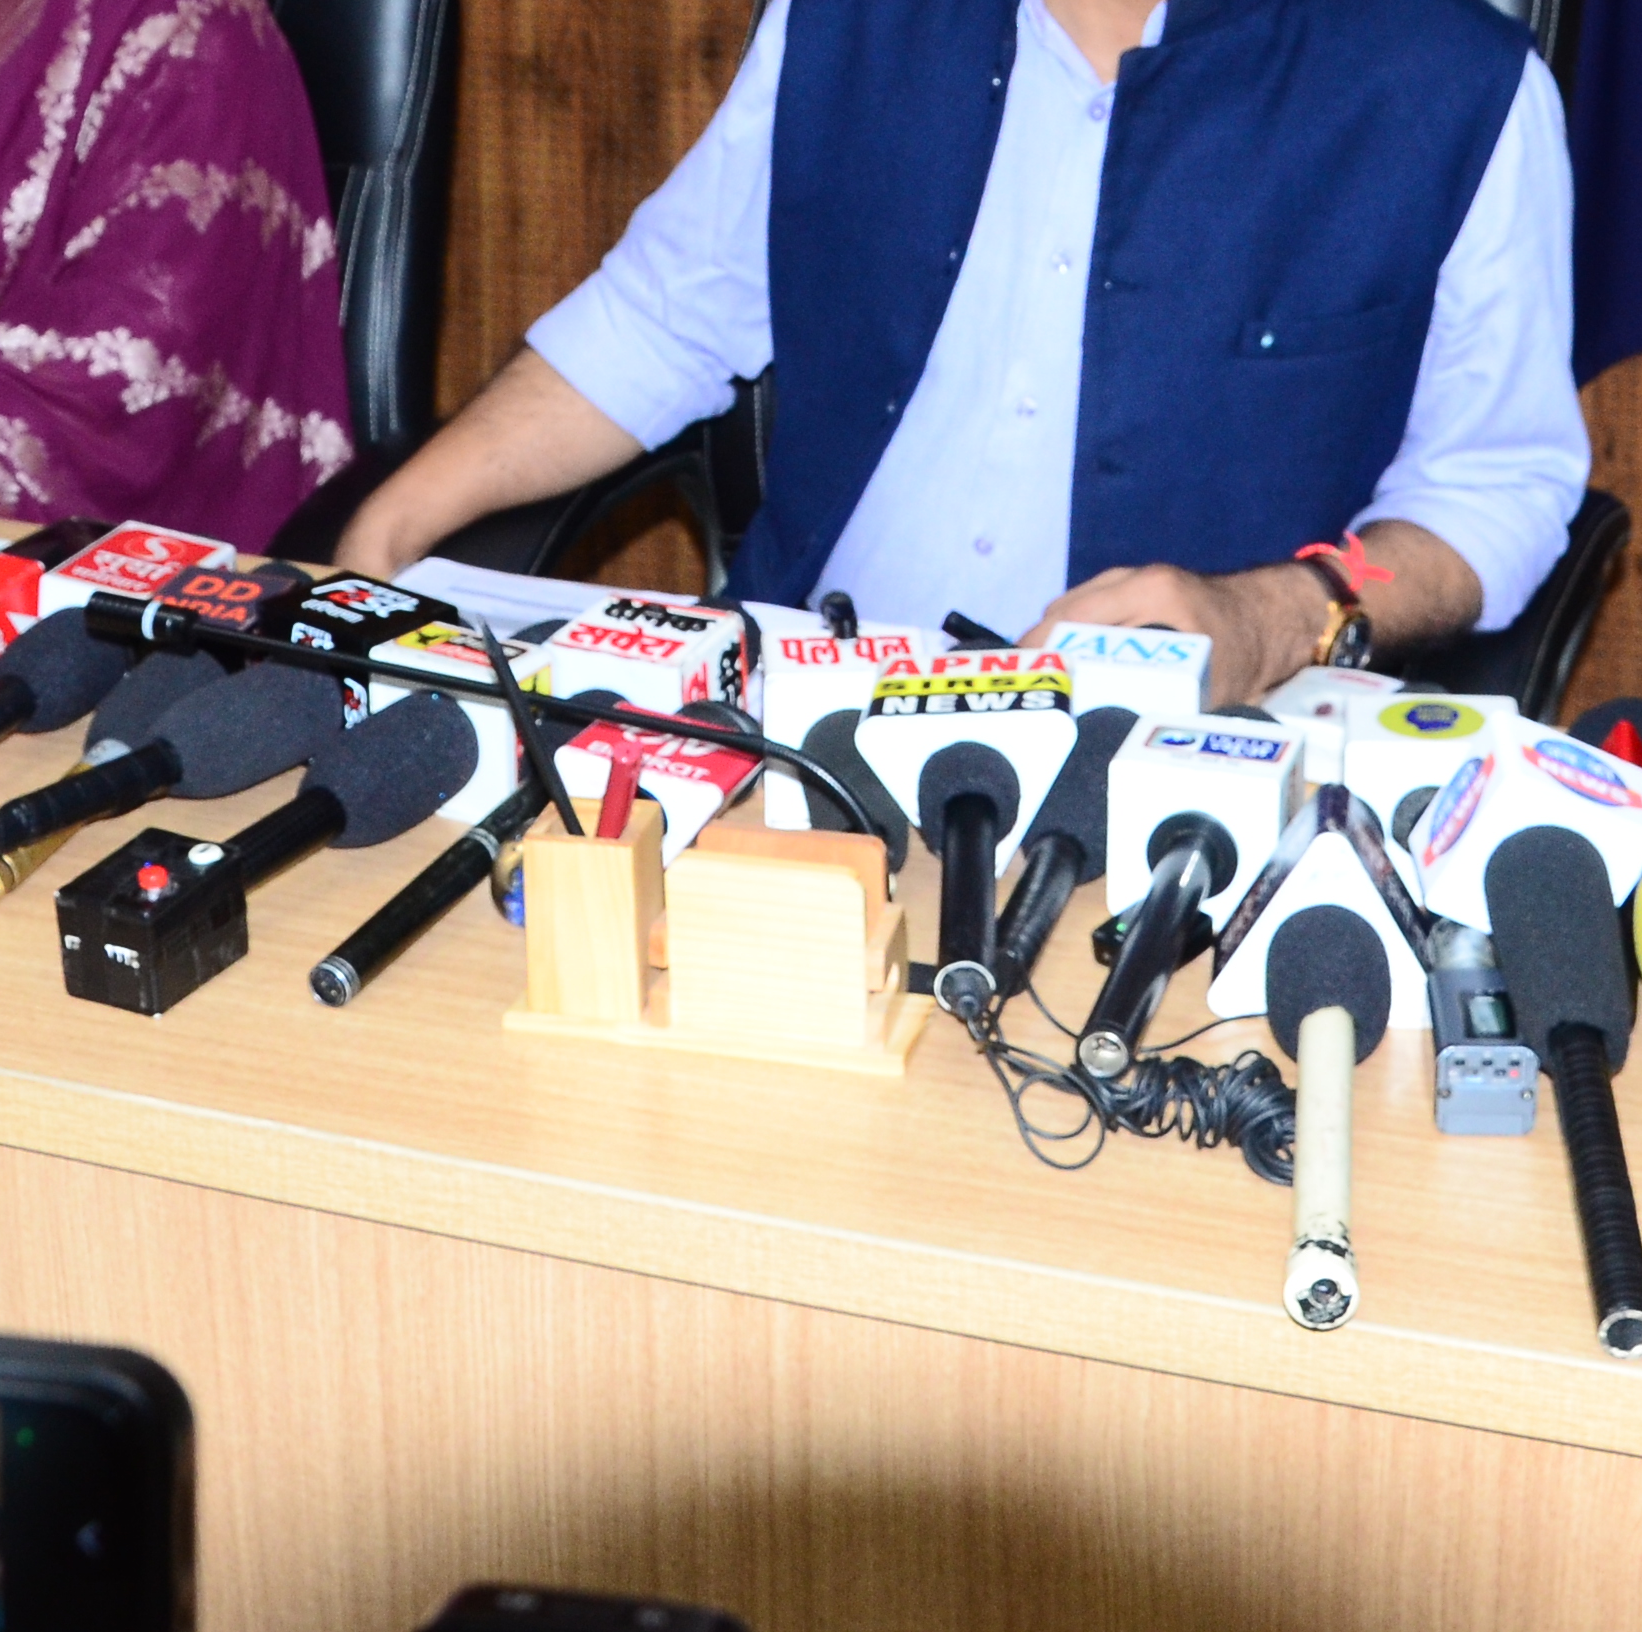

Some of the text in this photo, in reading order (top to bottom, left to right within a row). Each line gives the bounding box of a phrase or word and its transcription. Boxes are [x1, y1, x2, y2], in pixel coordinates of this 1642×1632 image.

[181, 574, 263, 603] DD
[568, 622, 686, 659] सवेरा
[1055, 631, 1198, 664] IANS
[882, 652, 1070, 677] APNA
[880, 674, 1064, 692] SIRSA
[880, 689, 1058, 716] NEWS
